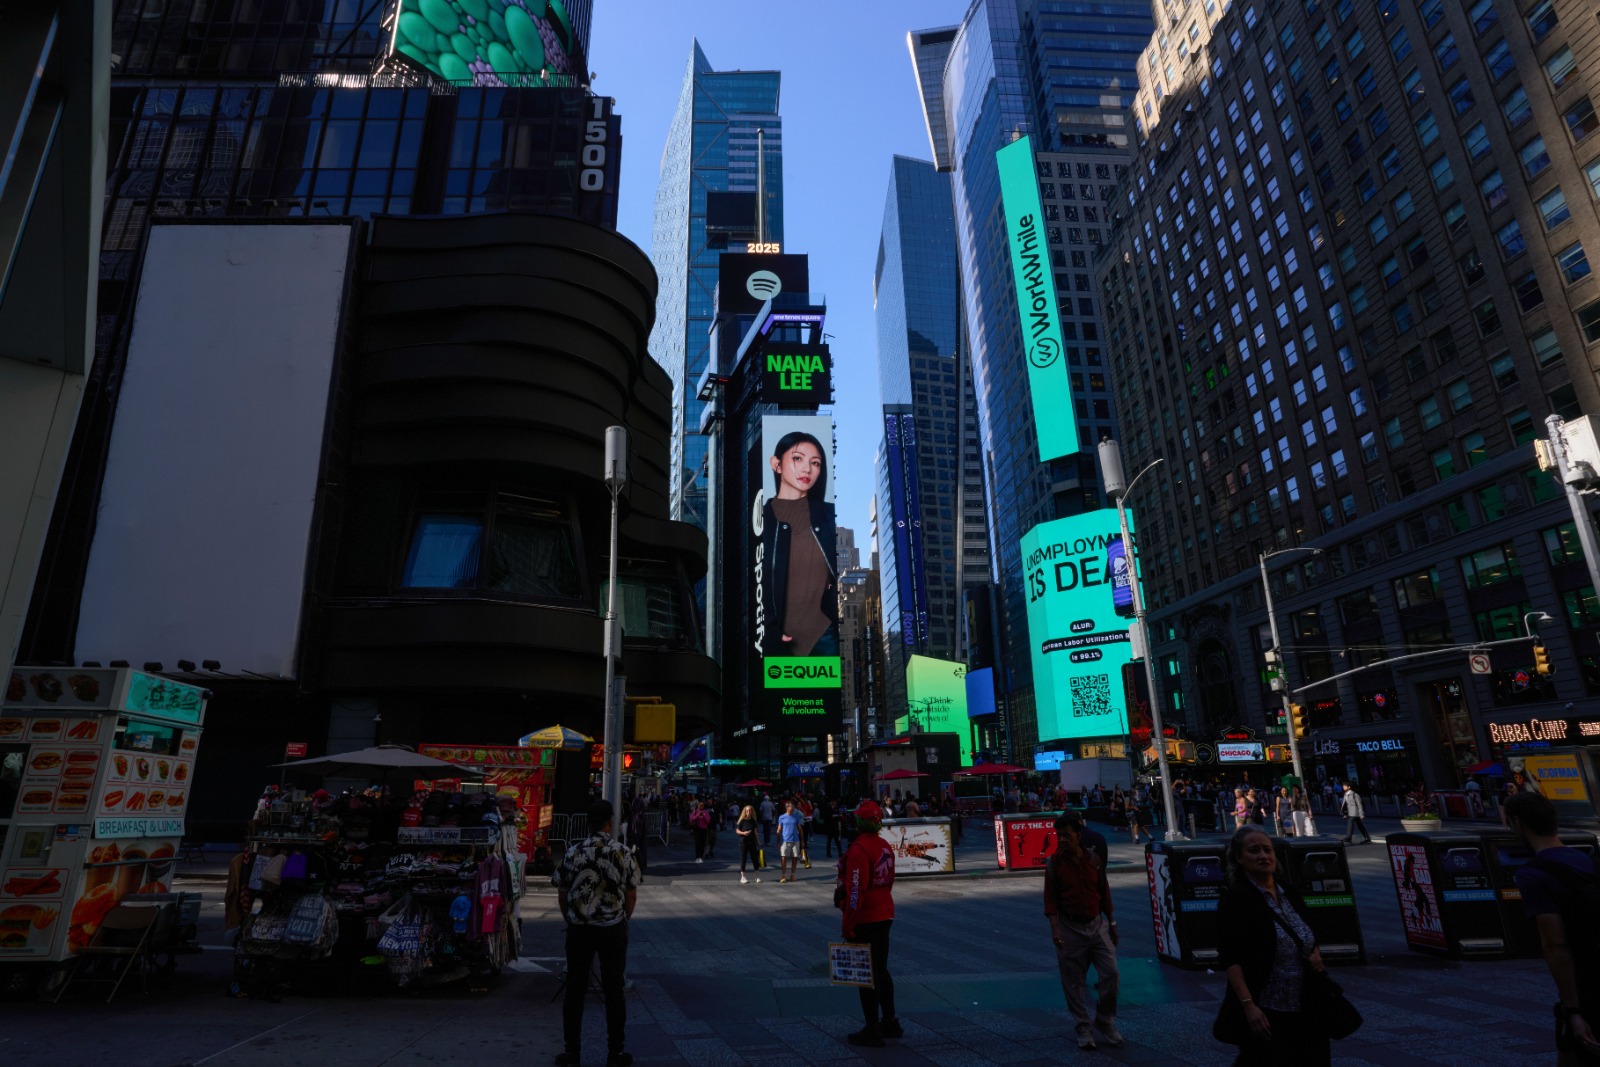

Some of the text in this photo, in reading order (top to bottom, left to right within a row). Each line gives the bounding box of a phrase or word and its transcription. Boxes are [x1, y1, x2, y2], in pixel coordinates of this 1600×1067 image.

[580, 98, 607, 191] 1500
[747, 243, 780, 254] 2025
[1017, 213, 1050, 338] WorkWhile
[767, 354, 825, 373] NANA
[780, 372, 813, 390] LEE
[1026, 532, 1137, 571] UNEMPLOYM
[1028, 556, 1113, 603] IS DE
[754, 541, 765, 657] Spotify
[1063, 639, 1084, 647] Labor
[1085, 633, 1124, 644] Utilization
[783, 665, 838, 679] EQUAL
[782, 697, 824, 706] Women at
[782, 706, 827, 715] full volume.
[1489, 722, 1533, 743] BUBBA
[1530, 719, 1568, 740] GUMP
[1356, 739, 1404, 752] TACO BELL
[99, 819, 182, 835] BREAKFAST & LUNCH
[1392, 855, 1407, 872] IT
[1413, 869, 1433, 885] BAD
[300, 896, 321, 908] NEW
[1146, 852, 1165, 953] CHICAGO
[1325, 897, 1352, 905] SQUARE
[291, 919, 315, 932] CITY
[400, 940, 419, 950] YOR
